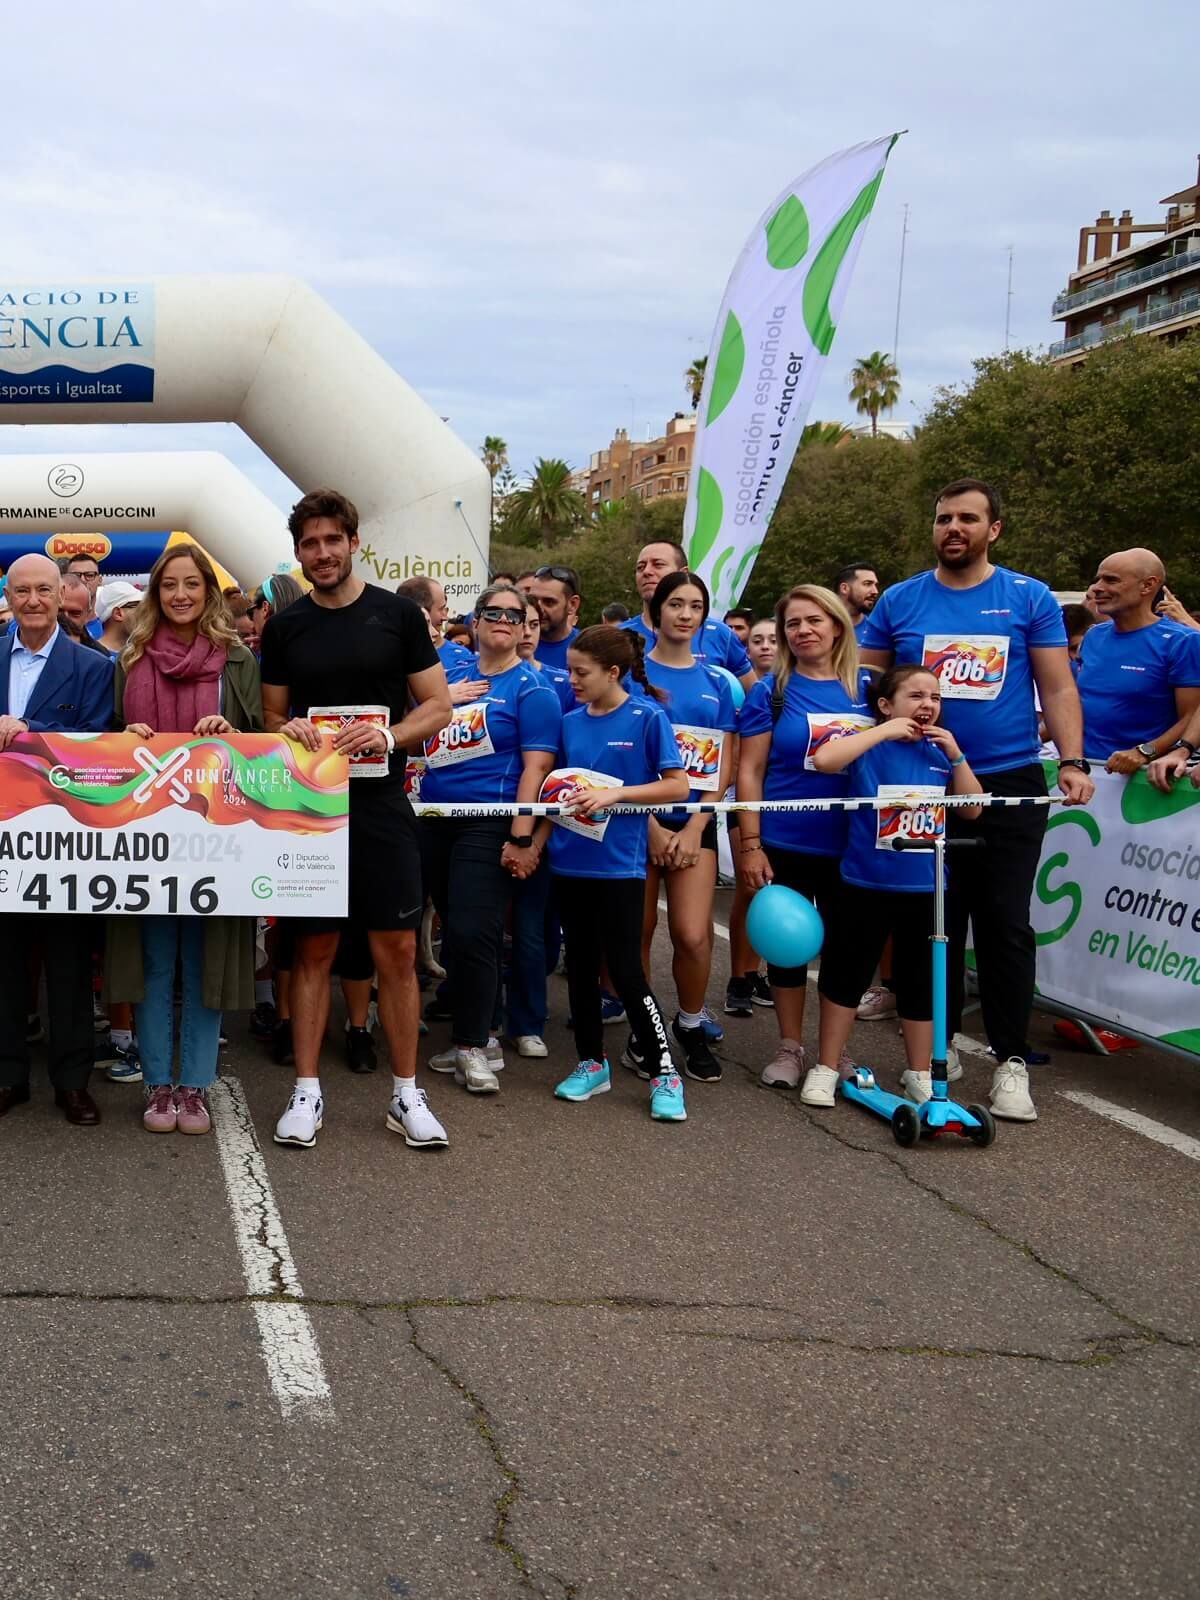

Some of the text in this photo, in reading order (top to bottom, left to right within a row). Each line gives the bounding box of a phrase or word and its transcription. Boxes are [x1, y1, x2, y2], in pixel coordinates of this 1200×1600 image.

[99, 290, 140, 305] DE
[56, 382, 60, 395] i
[66, 380, 122, 398] Igualtat
[734, 304, 787, 527] asociación española
[72, 507, 155, 518] CAPUCCINI
[53, 540, 105, 555] Dacsa
[374, 554, 472, 580] València
[444, 582, 480, 597] esports
[940, 658, 986, 682] 806
[438, 721, 472, 747] 903
[680, 749, 705, 773] 04
[223, 794, 246, 806] 2024
[603, 807, 637, 817] POLICIA
[898, 810, 936, 837] 803
[171, 832, 243, 863] 2024
[296, 853, 329, 862] Diputació
[306, 862, 336, 870] València
[22, 873, 219, 915] 419.516
[1104, 885, 1188, 928] contra
[1088, 929, 1120, 959] en
[643, 995, 669, 1050] SNOOPY
